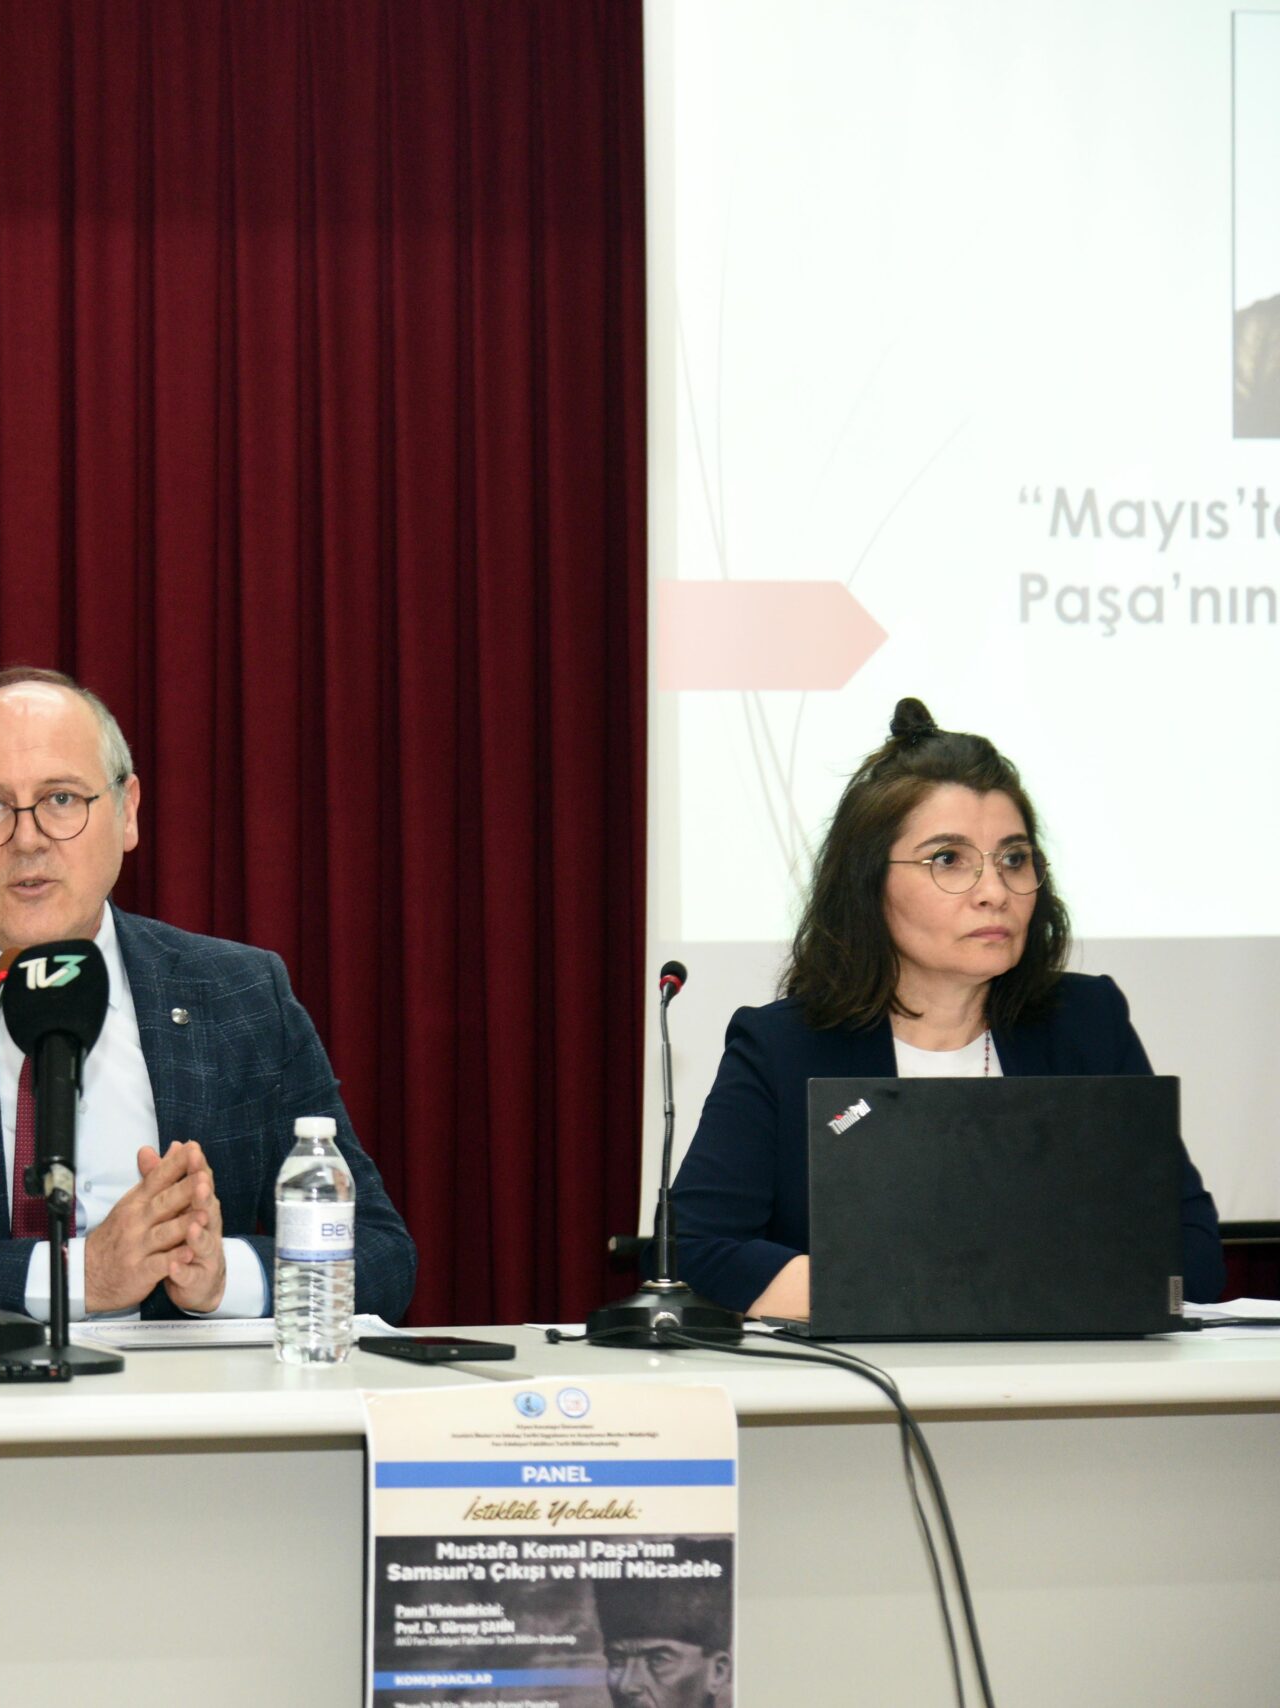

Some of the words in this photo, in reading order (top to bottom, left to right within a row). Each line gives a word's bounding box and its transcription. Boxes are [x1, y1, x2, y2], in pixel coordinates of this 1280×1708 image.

[1018, 484, 1280, 552] “Mayıs’t
[1019, 571, 1278, 638] Paşa’nın
[17, 955, 88, 990] TV3
[522, 1465, 592, 1483] PANEL
[436, 1540, 518, 1560] Mustafa
[522, 1540, 586, 1559] Kemal
[490, 1561, 546, 1582] Çıkışı
[551, 1565, 575, 1579] ve
[625, 1560, 722, 1578] Mücadele
[394, 1673, 493, 1688] KONUŞMACILAR
